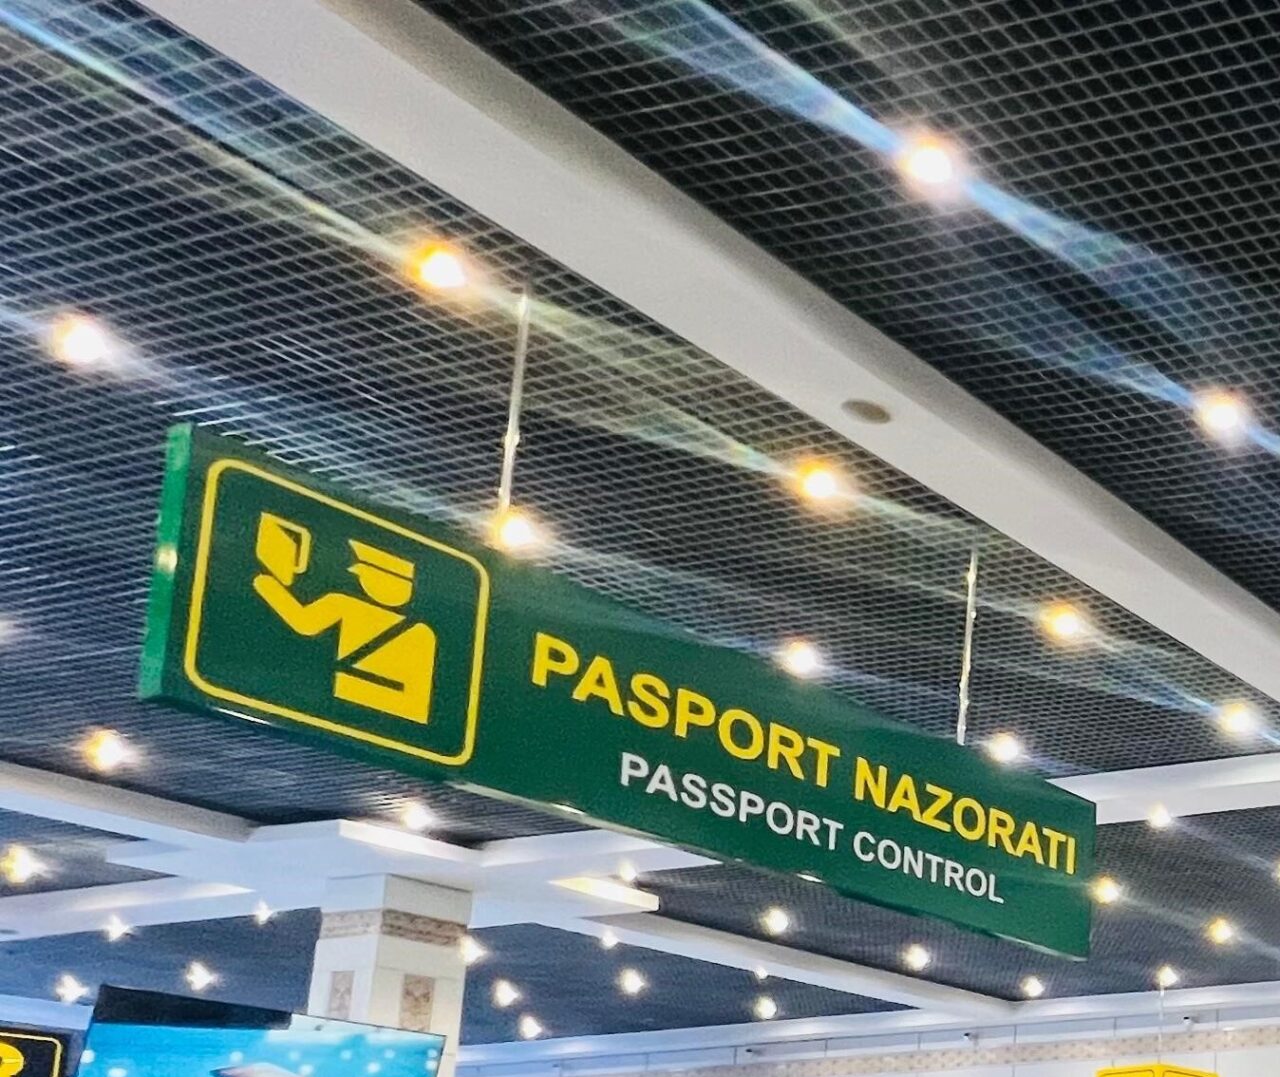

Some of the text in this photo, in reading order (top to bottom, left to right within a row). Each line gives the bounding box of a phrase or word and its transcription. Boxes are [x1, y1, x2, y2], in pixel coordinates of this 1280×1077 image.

[531, 632, 1076, 875] PASPORT NAZORATI
[619, 751, 1005, 904] PASSPORT CONTROL
